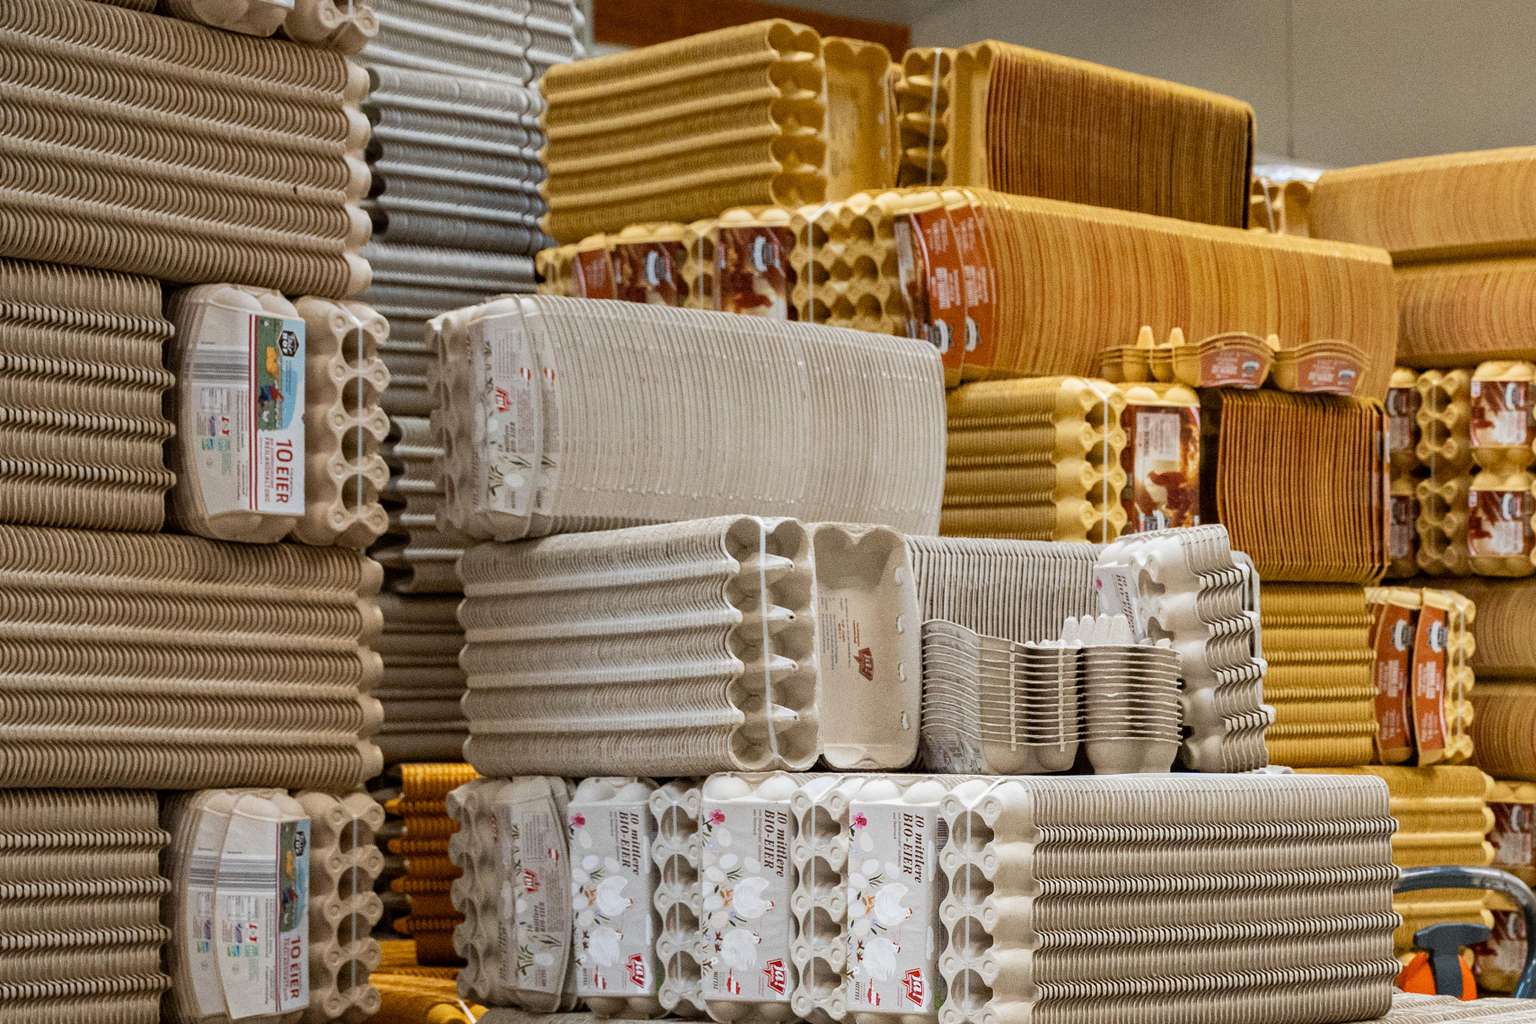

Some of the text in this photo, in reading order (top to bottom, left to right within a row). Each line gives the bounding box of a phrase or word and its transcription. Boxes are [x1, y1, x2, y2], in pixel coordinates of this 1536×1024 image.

[276, 438, 293, 504] 10 EIER
[618, 811, 631, 868] BIO-EIER
[629, 812, 642, 876] 10 mittlere
[764, 809, 775, 869] BIO-EIER
[776, 810, 788, 878] 10 mittlere
[903, 813, 913, 875] BIO-EIER
[914, 814, 927, 884] 10 mittlere
[290, 937, 301, 999] 10 EIER
[771, 964, 786, 994] ja!
[910, 974, 924, 1005] ja!
